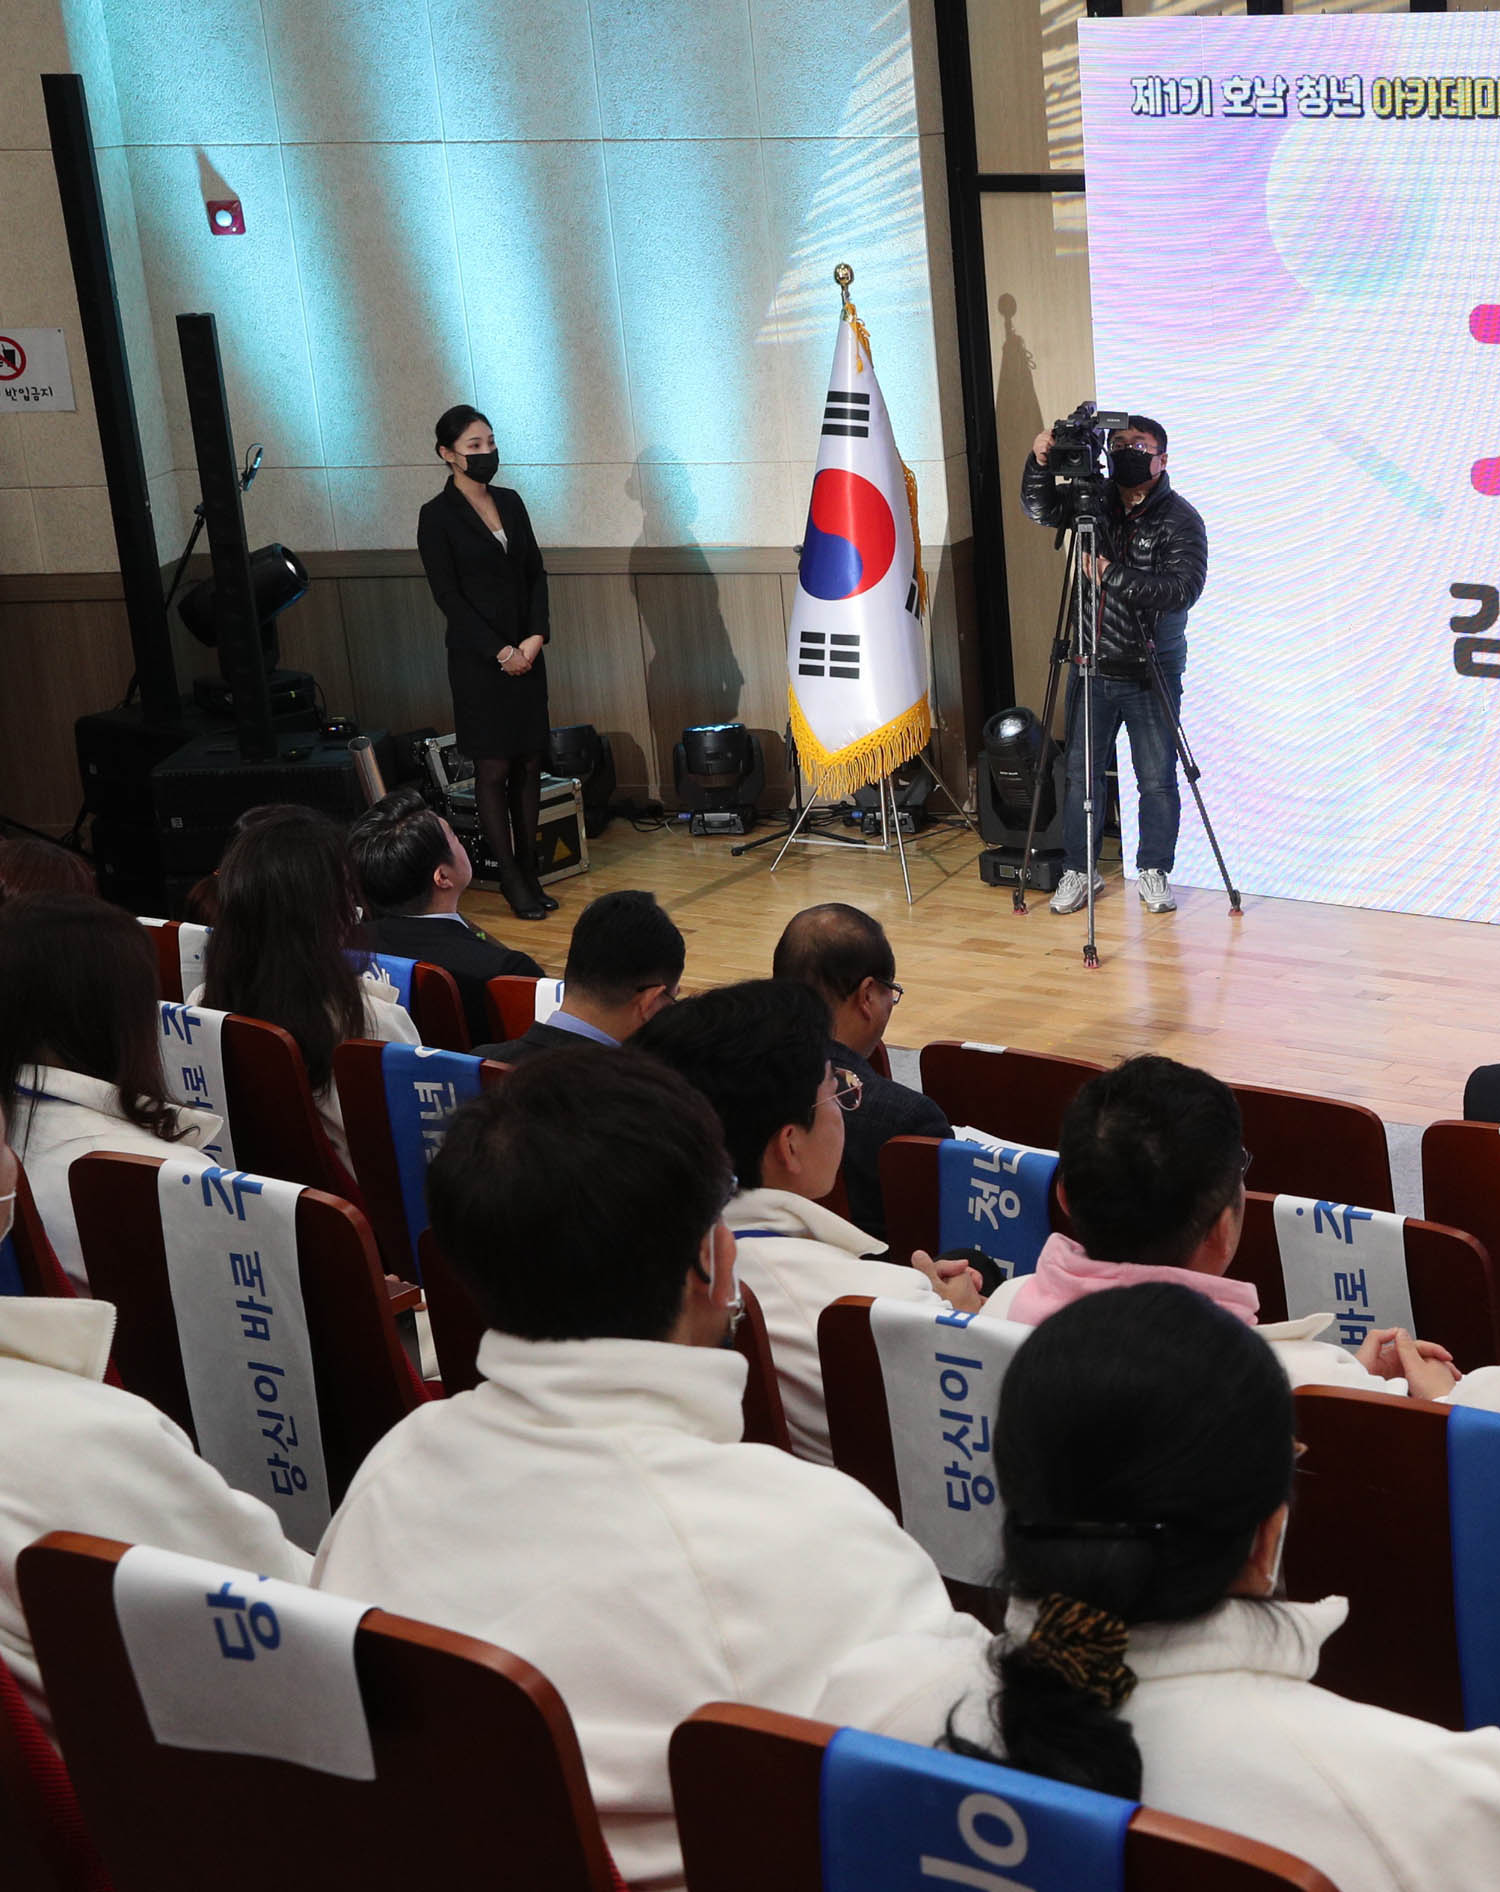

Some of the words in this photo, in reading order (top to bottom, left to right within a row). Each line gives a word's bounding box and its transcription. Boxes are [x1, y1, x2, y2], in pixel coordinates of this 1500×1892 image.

[1131, 75, 1213, 117] 제1기
[1221, 74, 1289, 118] 호남
[1296, 74, 1364, 119] 청년
[5, 386, 54, 402] 반입금지
[229, 1251, 273, 1341] 바로
[1334, 1268, 1375, 1345] 바로
[247, 1361, 308, 1496] 당신이
[935, 1352, 995, 1512] 당신이
